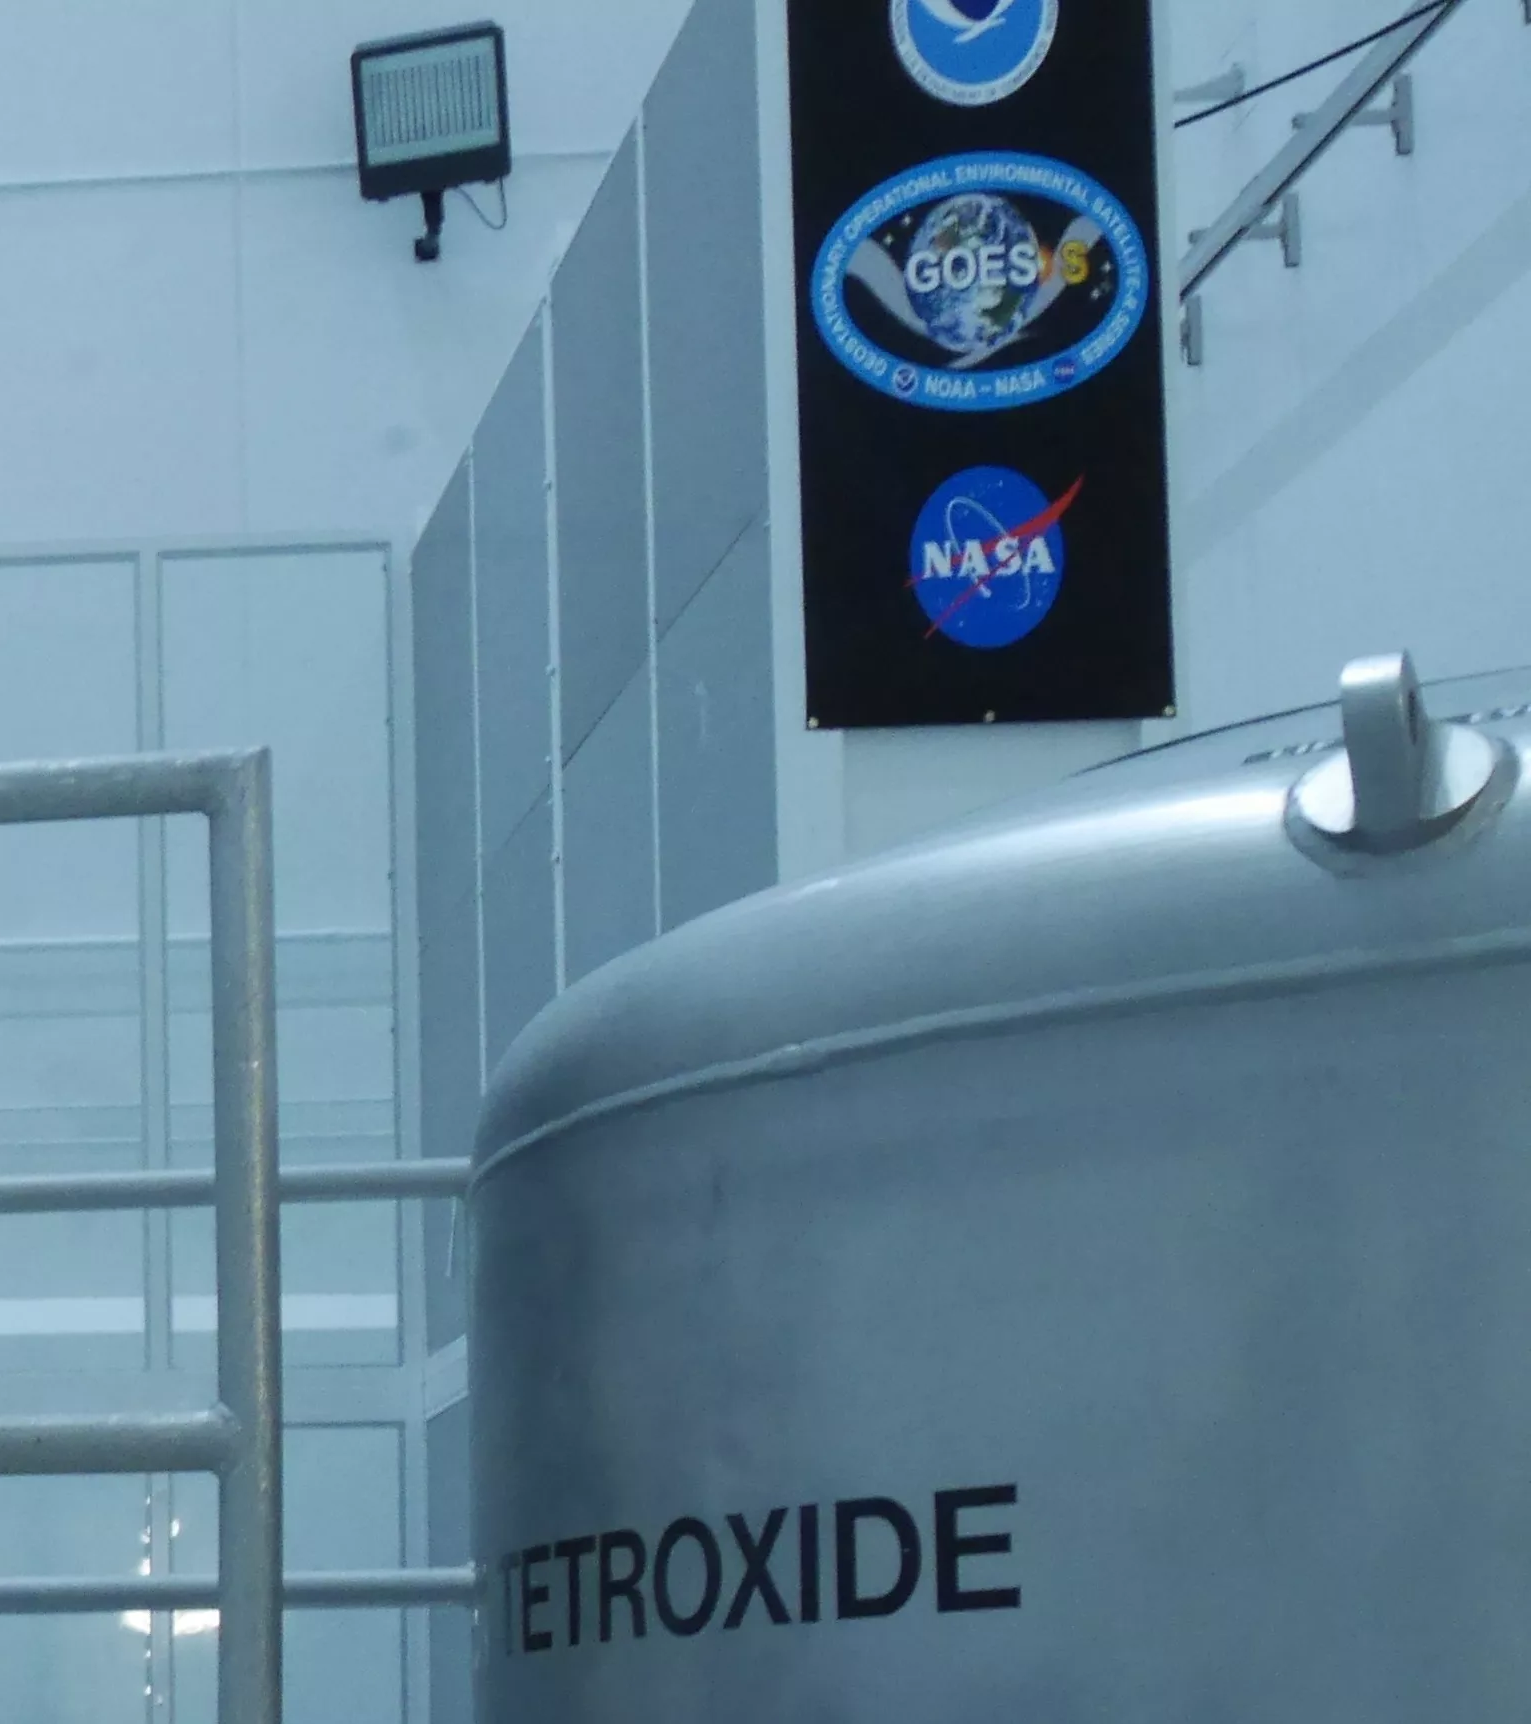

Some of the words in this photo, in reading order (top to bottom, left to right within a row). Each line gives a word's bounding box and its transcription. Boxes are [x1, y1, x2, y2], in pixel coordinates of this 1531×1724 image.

[843, 168, 953, 242] OPERATIONAL
[955, 162, 1089, 205] ENVIRONMENTAL
[905, 241, 1039, 295] GOES
[1060, 238, 1090, 286] S
[925, 374, 978, 400] NOAA
[995, 367, 1047, 399] NASA
[921, 535, 1056, 579] NASA
[501, 1483, 1023, 1657] TETROXIDE
